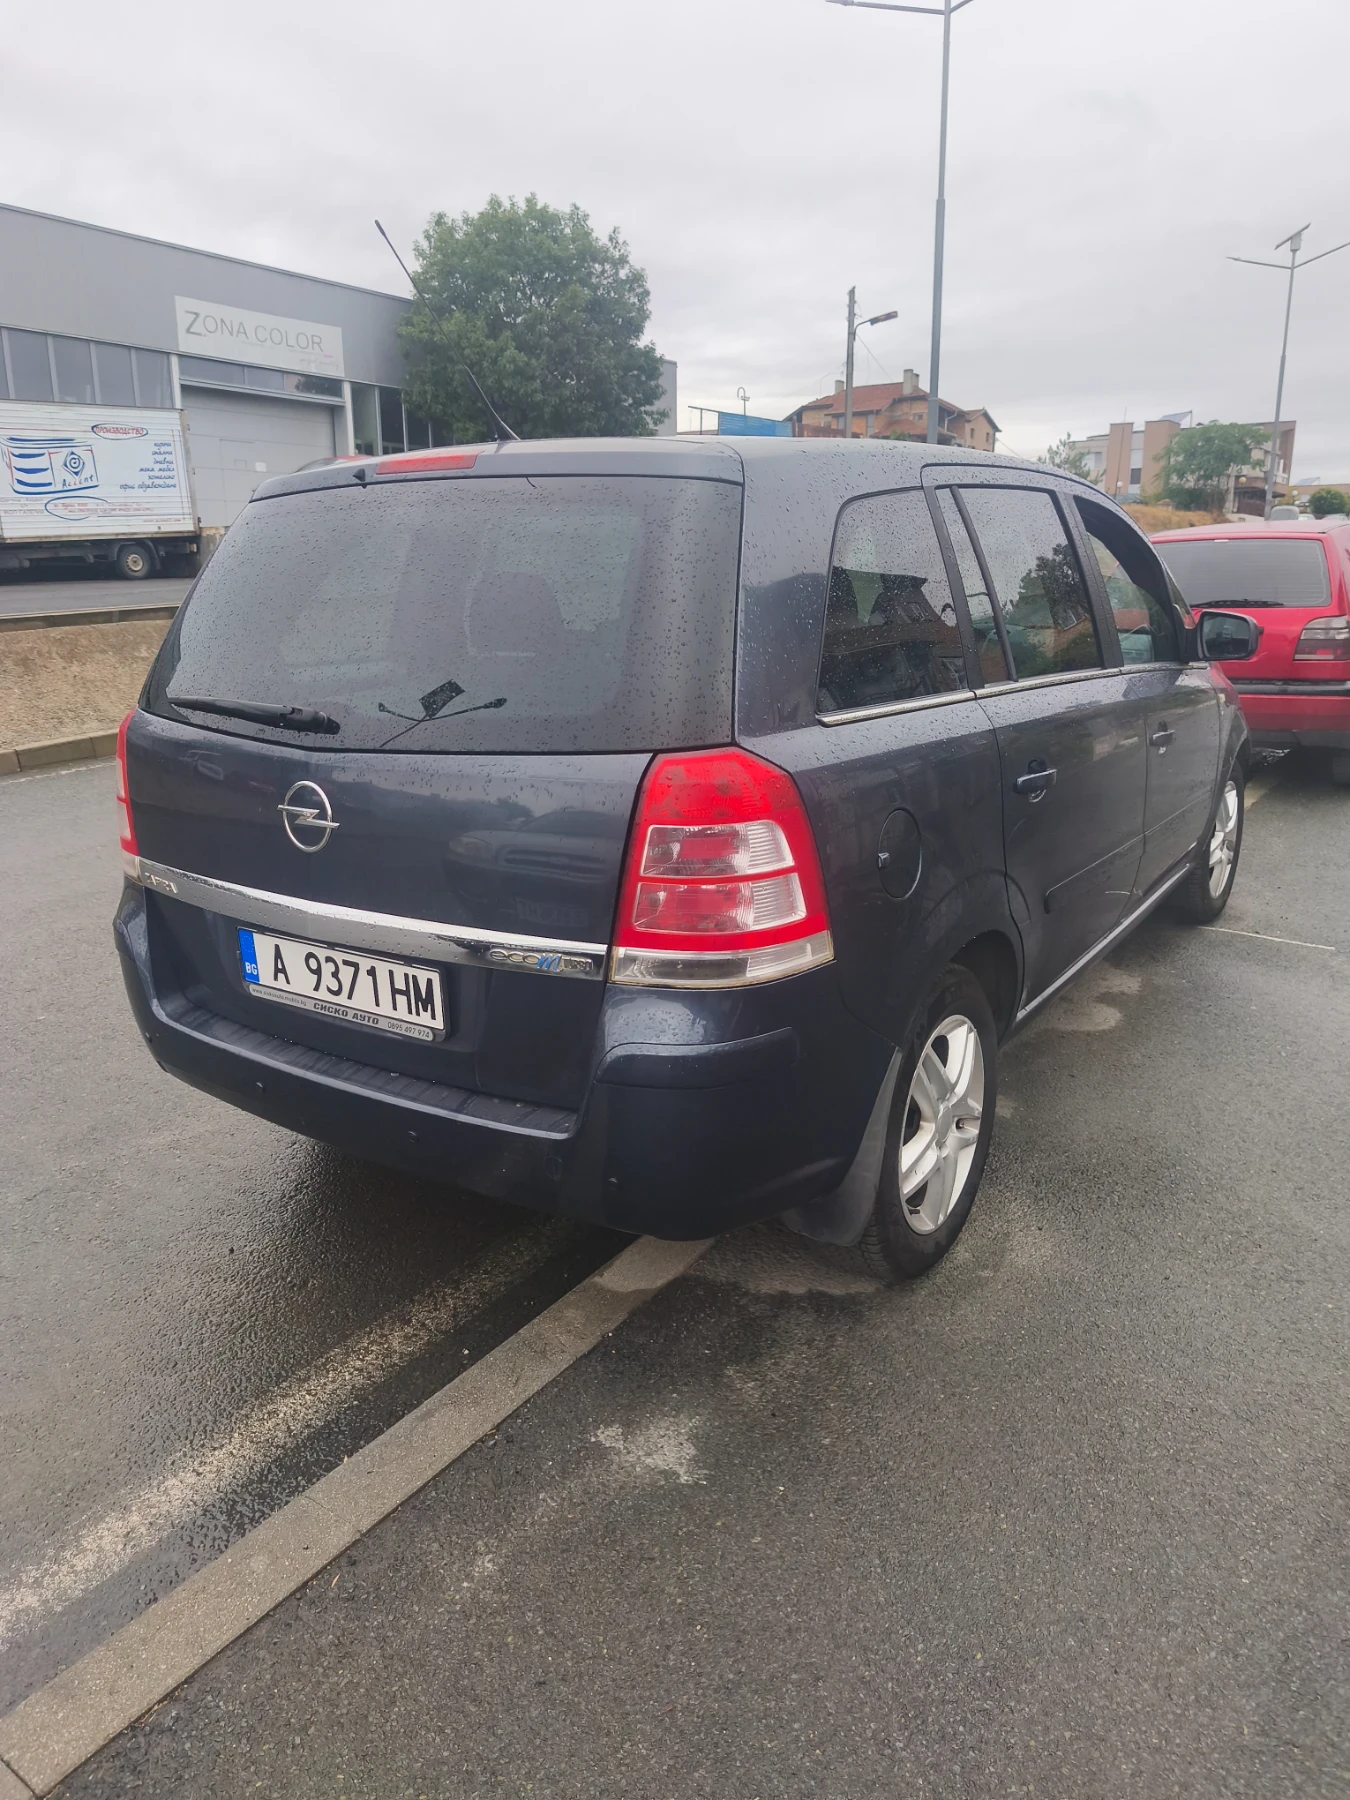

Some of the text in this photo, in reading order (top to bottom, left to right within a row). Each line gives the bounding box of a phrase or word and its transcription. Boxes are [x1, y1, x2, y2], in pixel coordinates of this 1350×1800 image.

[184, 310, 324, 352] ZONA COLOR
[94, 426, 144, 435] ПРОИЗВОДСТВО
[245, 961, 258, 975] BG
[273, 943, 291, 985] A
[313, 1002, 349, 1017] СИСКО
[404, 1025, 416, 1035] 497
[417, 1029, 430, 1038] 974
